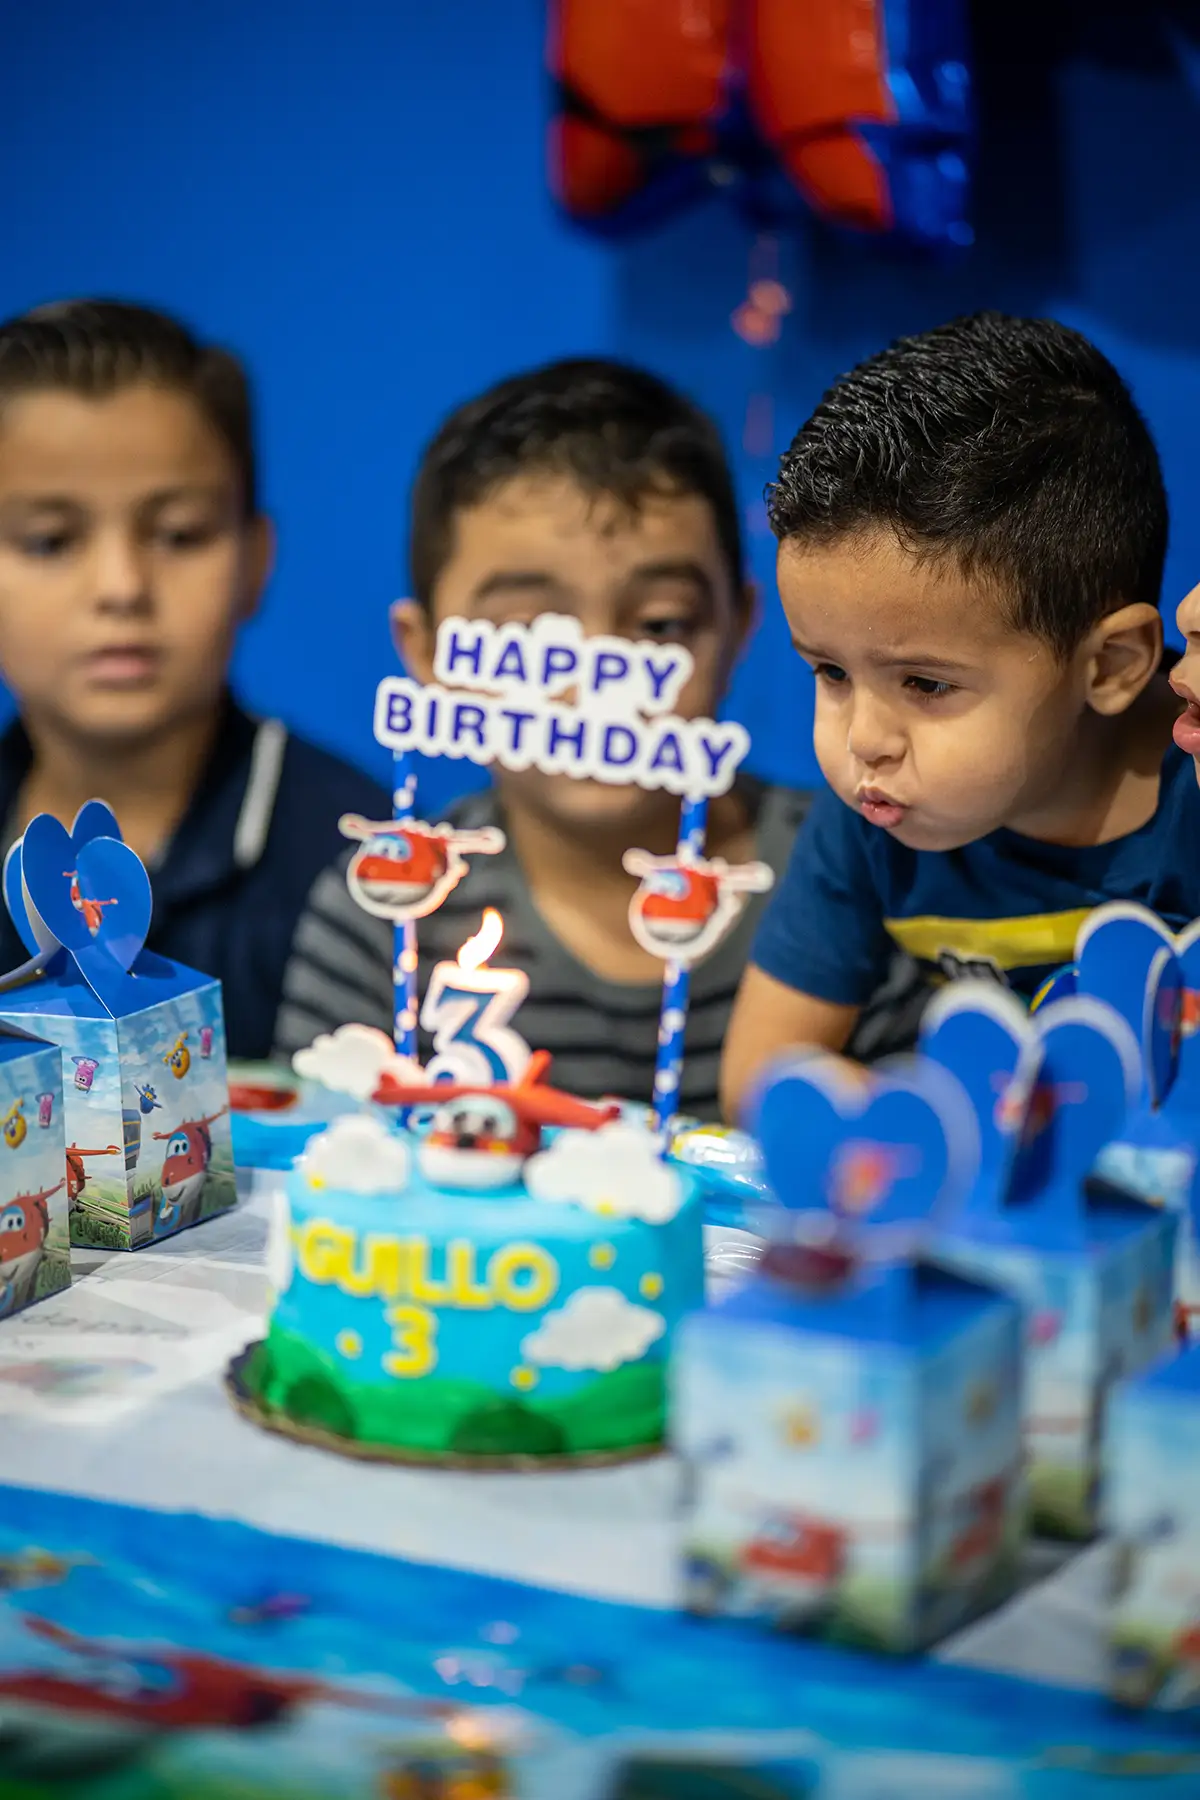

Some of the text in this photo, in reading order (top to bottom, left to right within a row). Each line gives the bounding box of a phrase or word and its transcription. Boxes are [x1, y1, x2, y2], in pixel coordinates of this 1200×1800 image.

[446, 632, 678, 699] HAPPY
[385, 693, 733, 778] BIRTHDAY
[425, 971, 522, 1086] 3
[299, 1218, 560, 1312] GUILLO
[384, 1305, 437, 1378] 3
